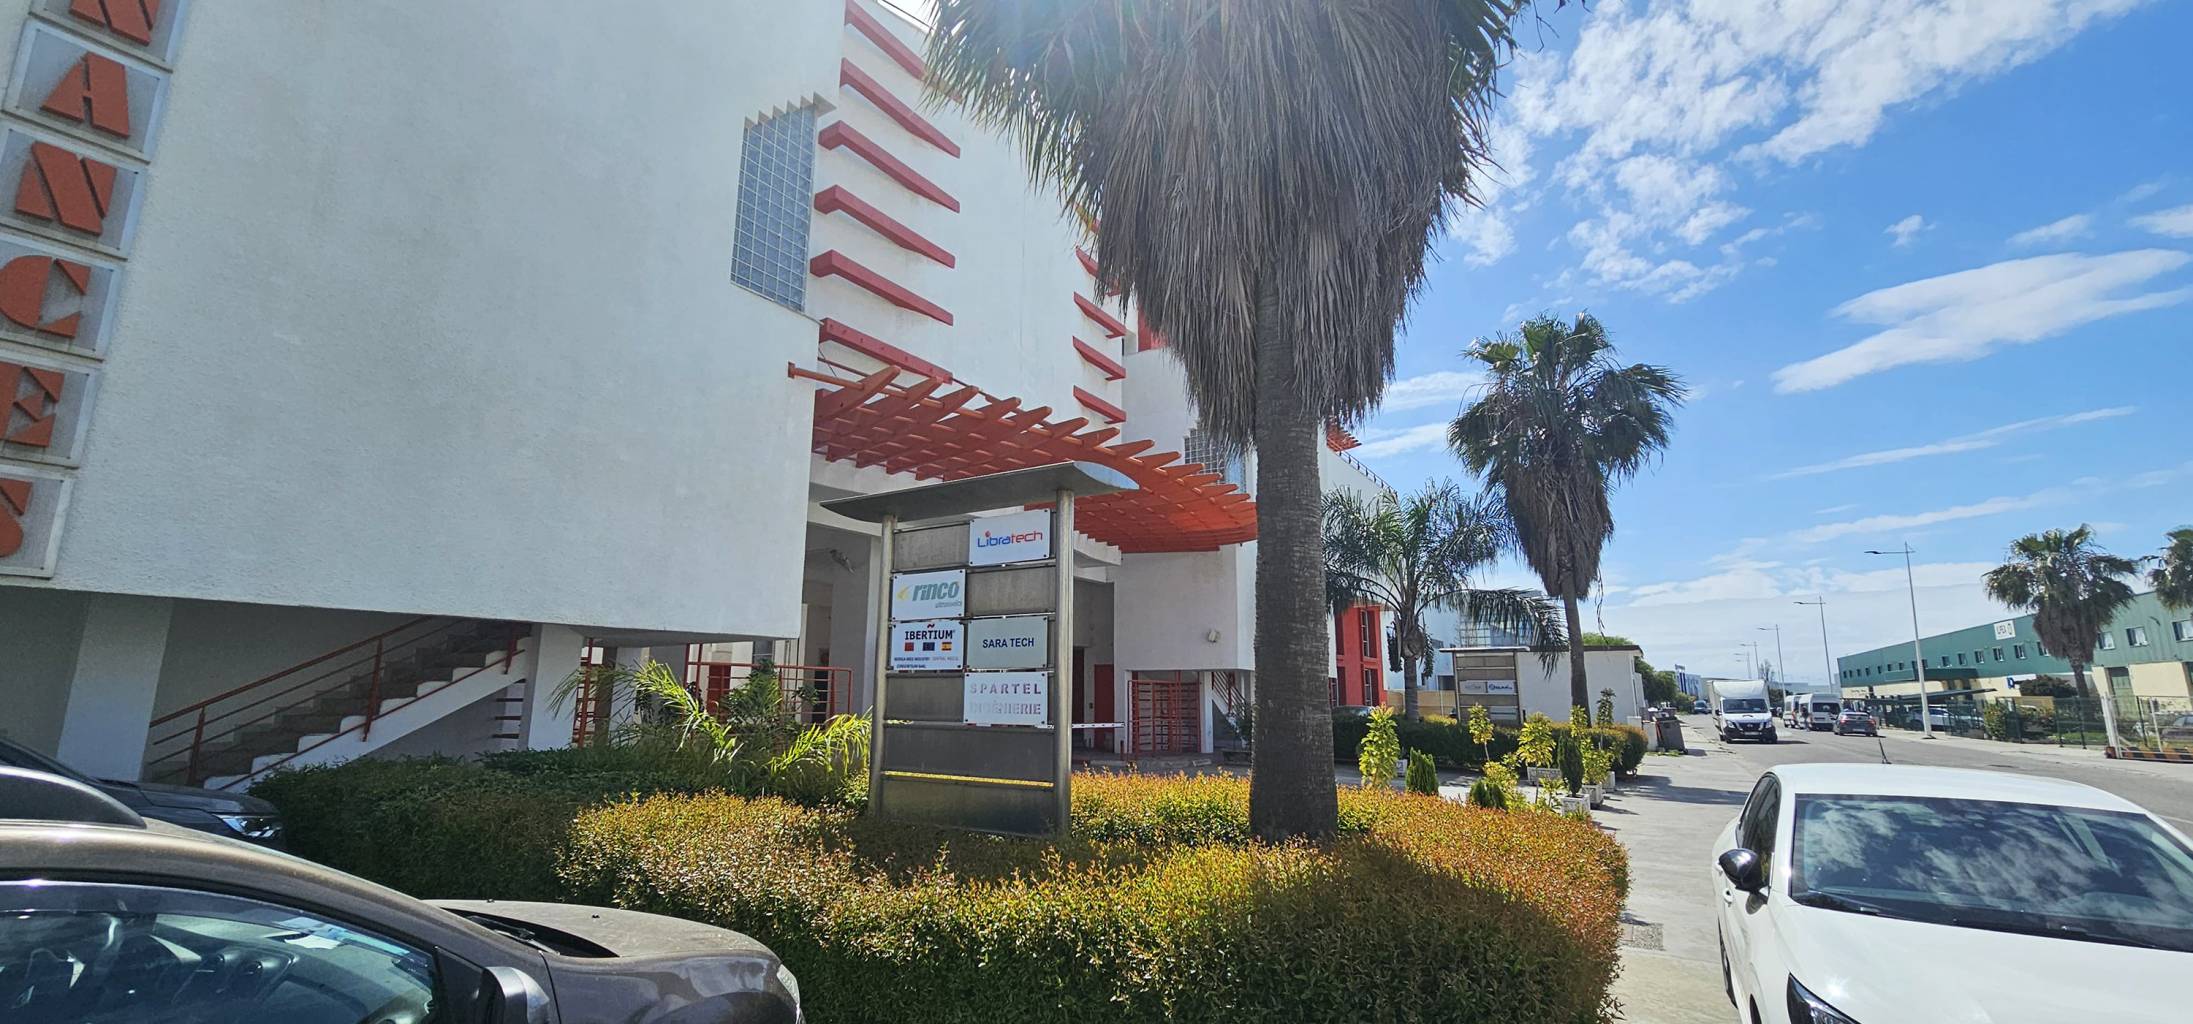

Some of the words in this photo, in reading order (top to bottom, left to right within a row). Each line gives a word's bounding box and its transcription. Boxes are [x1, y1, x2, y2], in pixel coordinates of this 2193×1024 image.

[977, 530, 1043, 548] Libratech
[912, 581, 960, 602] rinco
[982, 638, 1008, 649] SARA
[1010, 637, 1035, 648] TECH
[970, 682, 1042, 695] SPARTEL
